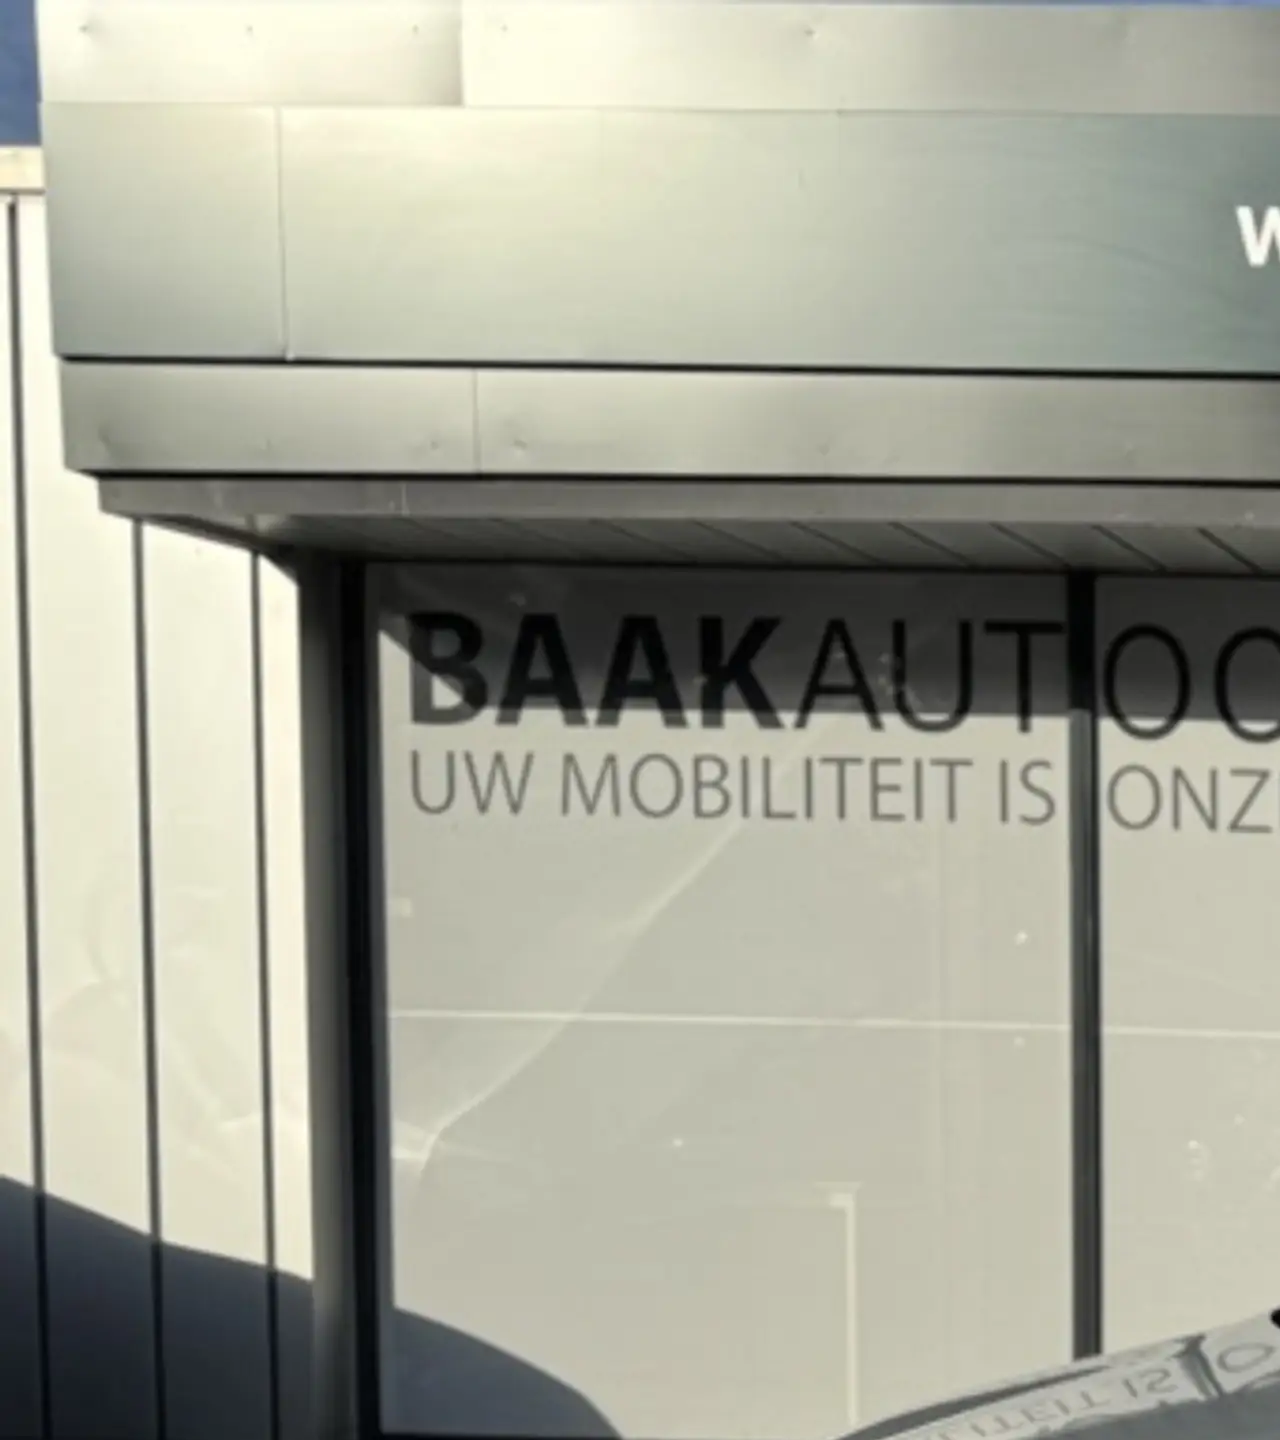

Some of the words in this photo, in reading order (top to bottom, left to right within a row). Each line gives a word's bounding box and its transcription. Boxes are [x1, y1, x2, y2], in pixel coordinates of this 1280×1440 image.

[411, 749, 535, 816] UW
[561, 752, 974, 823] MOBILITEIT
[999, 759, 1057, 825] IS
